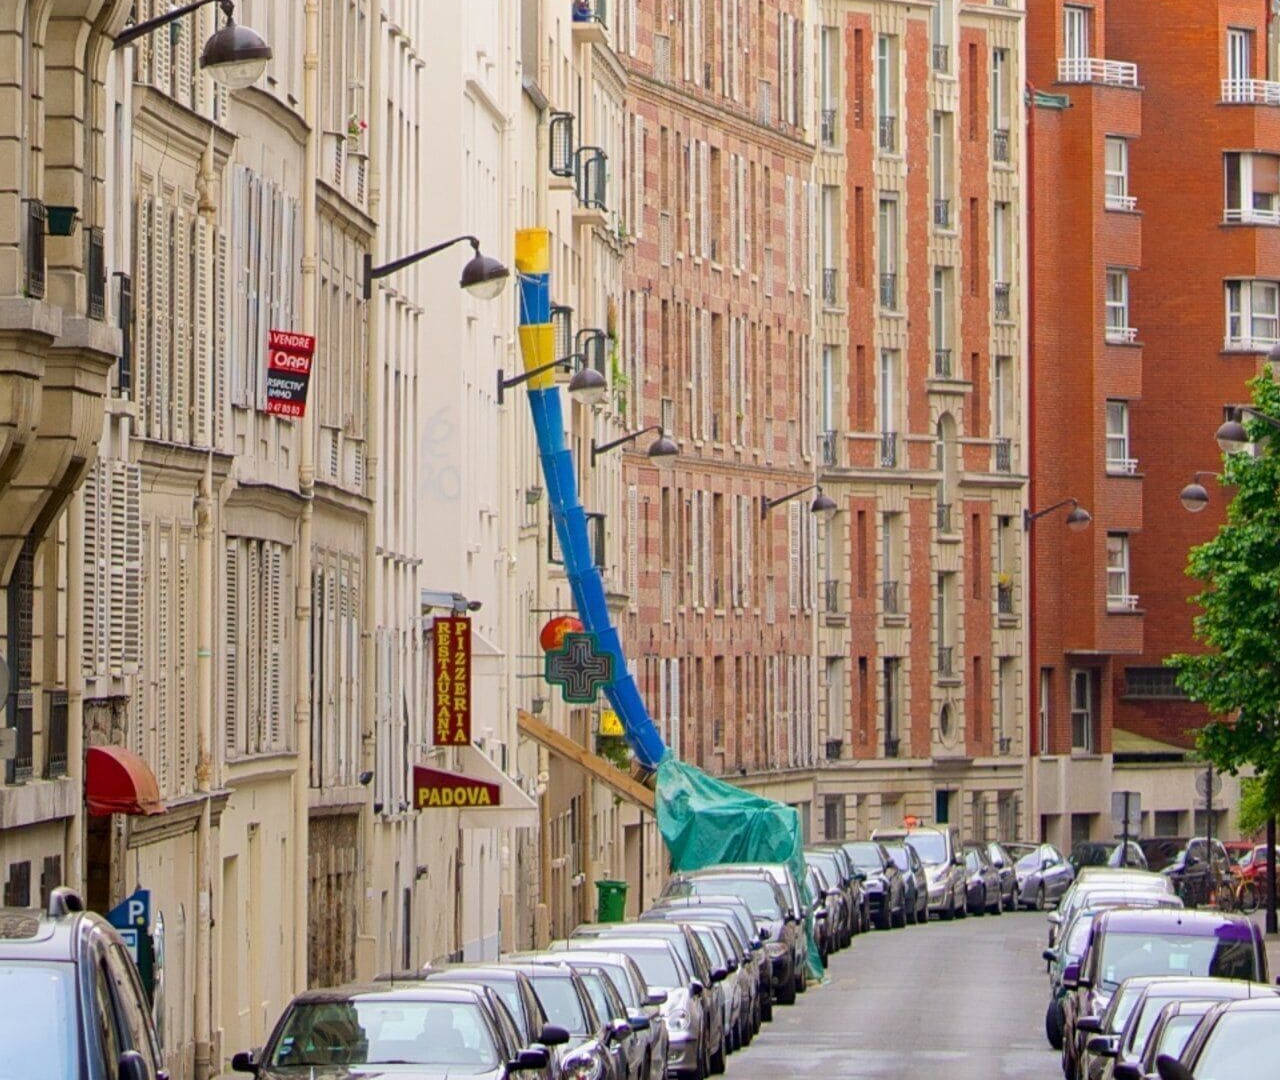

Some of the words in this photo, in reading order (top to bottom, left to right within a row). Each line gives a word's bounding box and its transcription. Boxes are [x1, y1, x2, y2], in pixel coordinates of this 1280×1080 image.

[273, 332, 310, 349] VENDRE
[274, 351, 309, 370] ORPI
[268, 388, 292, 400] IMMO
[436, 622, 451, 744] RESTAURANT
[454, 622, 467, 743] PIZZERIA
[418, 786, 491, 806] PADOVA
[128, 900, 144, 925] P
